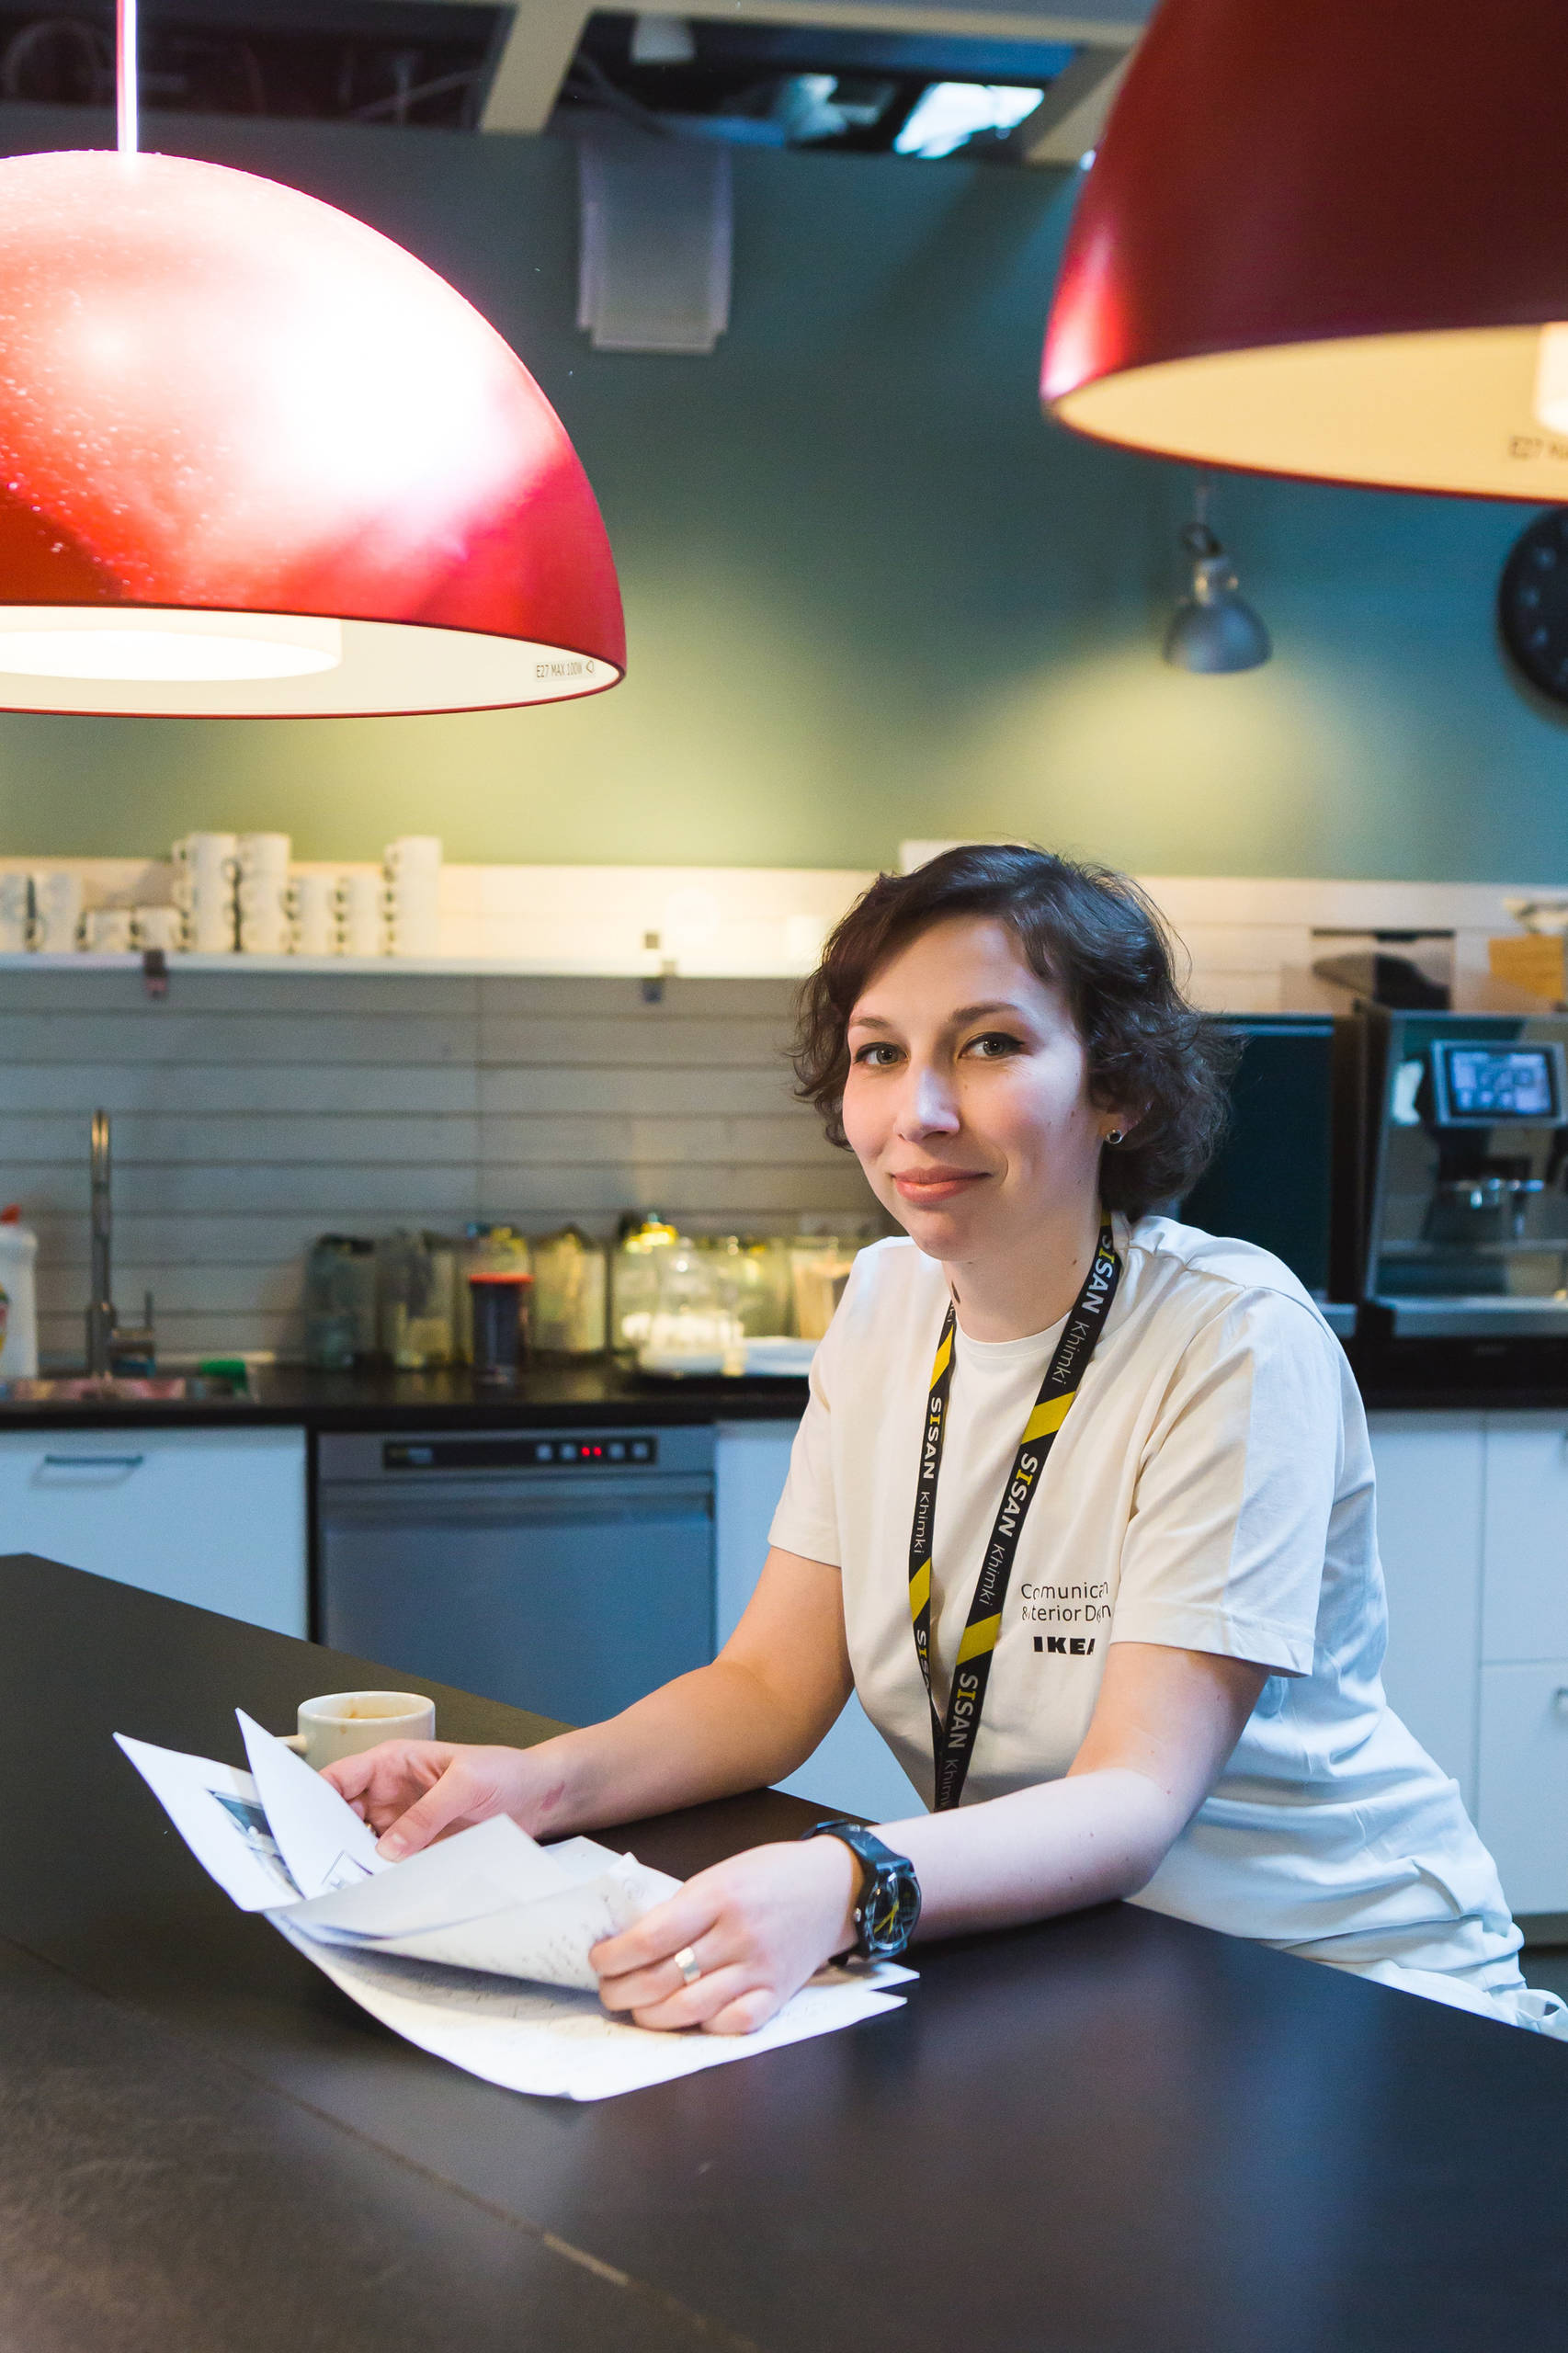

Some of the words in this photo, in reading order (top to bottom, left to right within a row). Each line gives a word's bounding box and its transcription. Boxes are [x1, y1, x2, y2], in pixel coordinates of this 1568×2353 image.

[537, 665, 550, 677] E27
[1051, 1320, 1091, 1385] Khimki
[923, 1396, 942, 1480] SISAN
[914, 1491, 931, 1554] Khimki
[997, 1452, 1039, 1538] SISAN
[978, 1543, 1006, 1607] Khimki
[948, 1673, 979, 1748] SISAN
[938, 1758, 960, 1809] Khim
